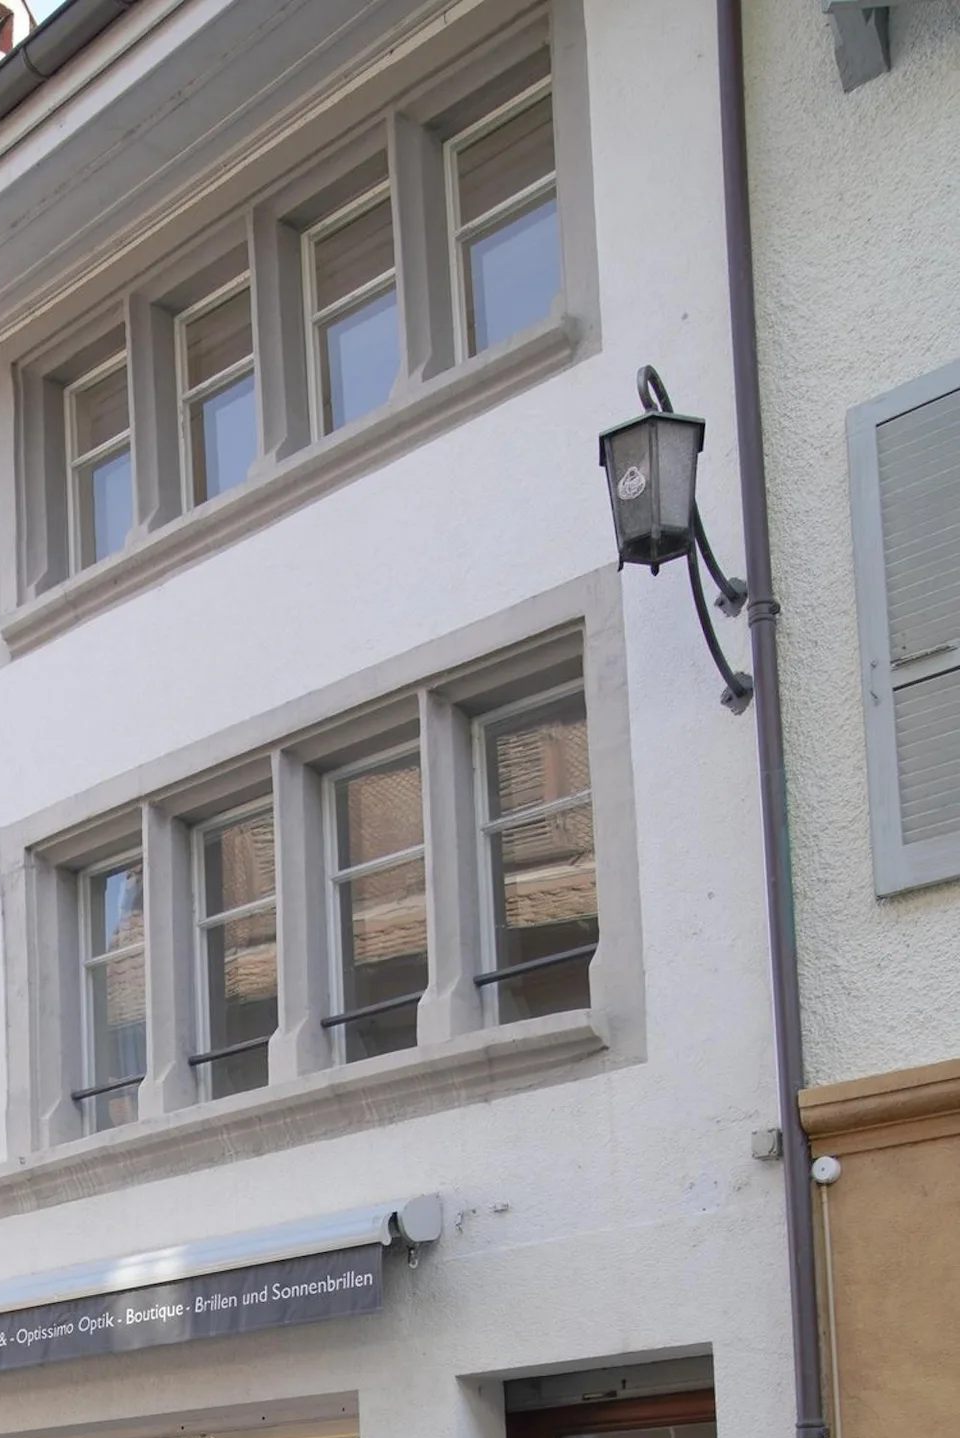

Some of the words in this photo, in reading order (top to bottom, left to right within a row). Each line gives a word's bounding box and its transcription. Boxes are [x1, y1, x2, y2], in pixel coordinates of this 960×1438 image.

[16, 1322, 74, 1347] Optissimo
[78, 1312, 115, 1335] Optik
[126, 1303, 184, 1325] Boutique
[194, 1293, 238, 1314] Brillen
[242, 1285, 268, 1306] und
[272, 1271, 374, 1301] Sonnenbrillen
